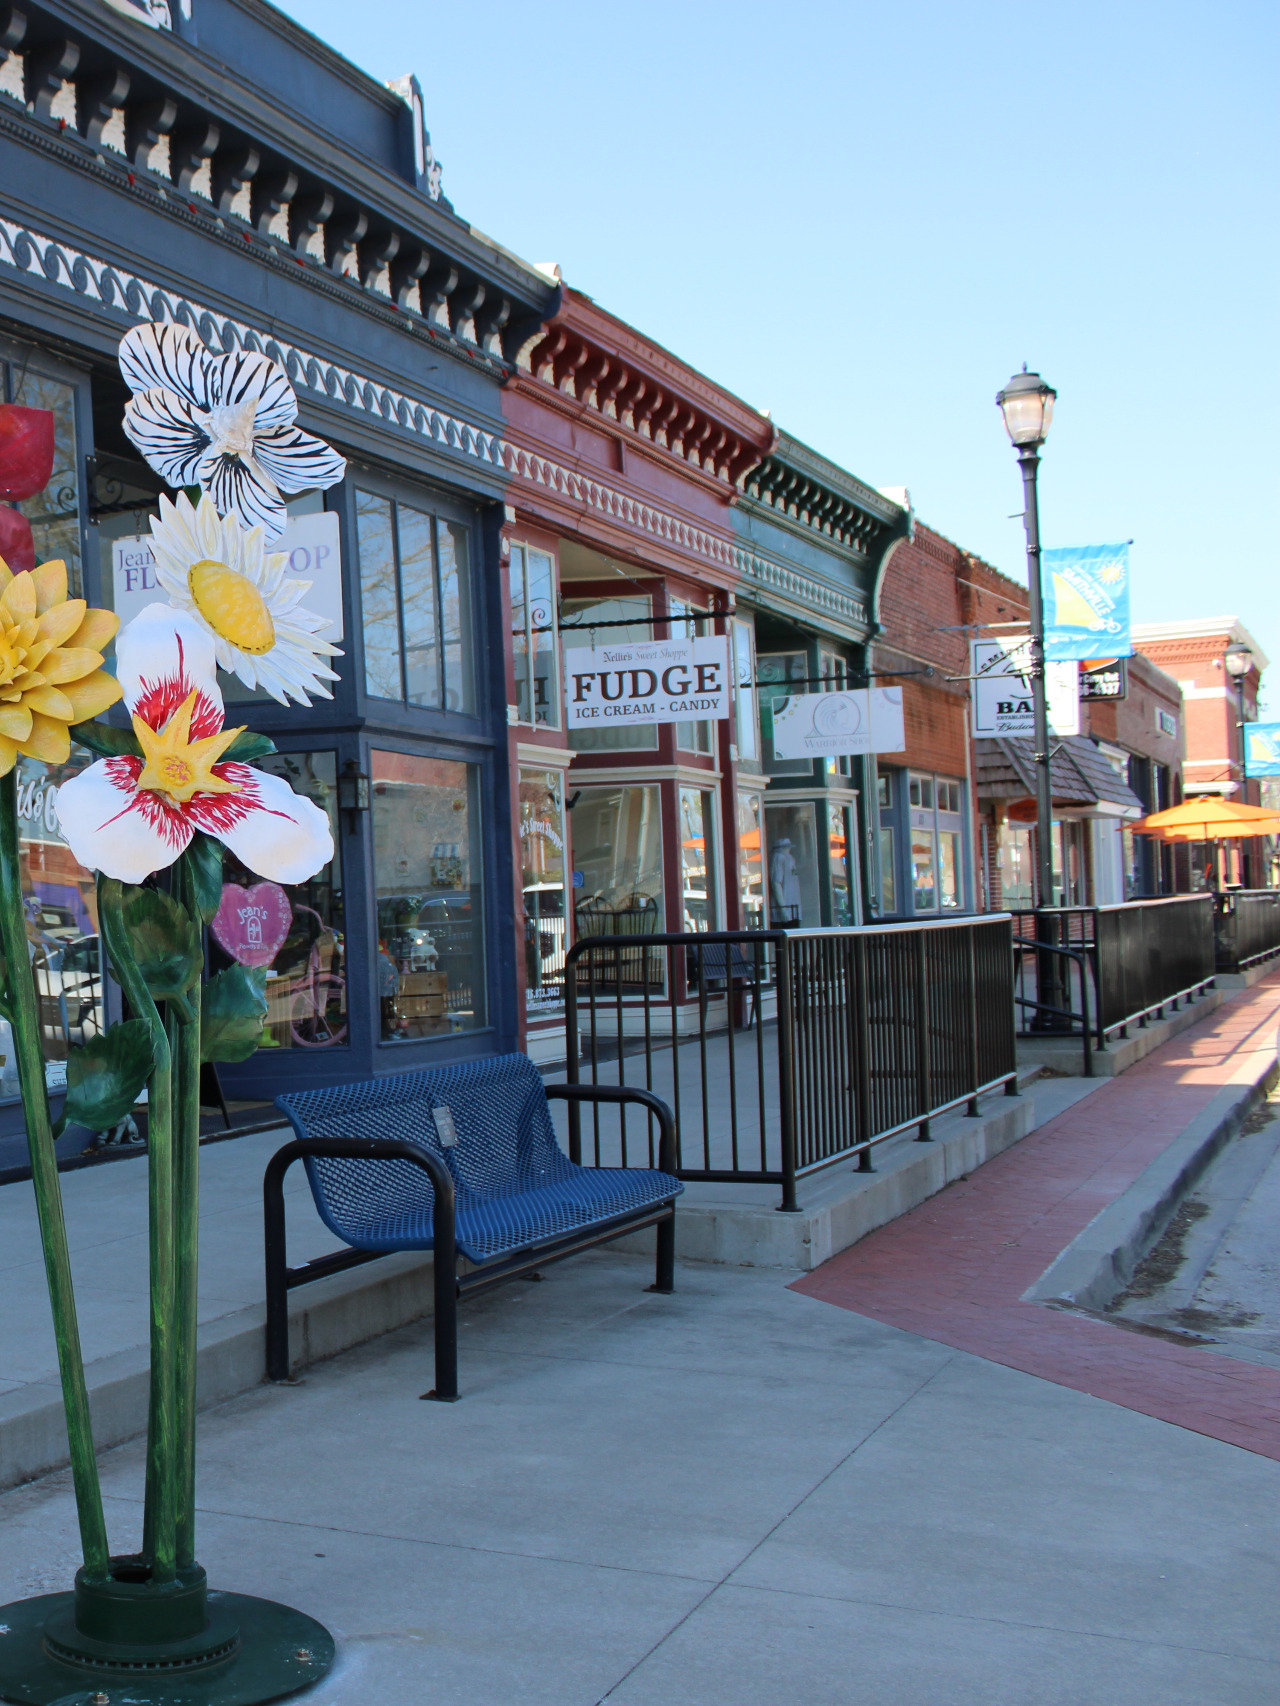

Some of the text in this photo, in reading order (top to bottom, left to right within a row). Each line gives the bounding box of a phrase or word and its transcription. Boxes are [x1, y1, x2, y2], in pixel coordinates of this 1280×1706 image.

[1059, 567, 1111, 617] SMITHVILLE
[603, 648, 689, 663] Nellie's Sweet Shoppe
[572, 663, 722, 702] FUDGE
[575, 708, 600, 719] ICE
[603, 703, 656, 717] CREAM
[669, 698, 721, 712] CANDY
[236, 905, 269, 925] Jean's
